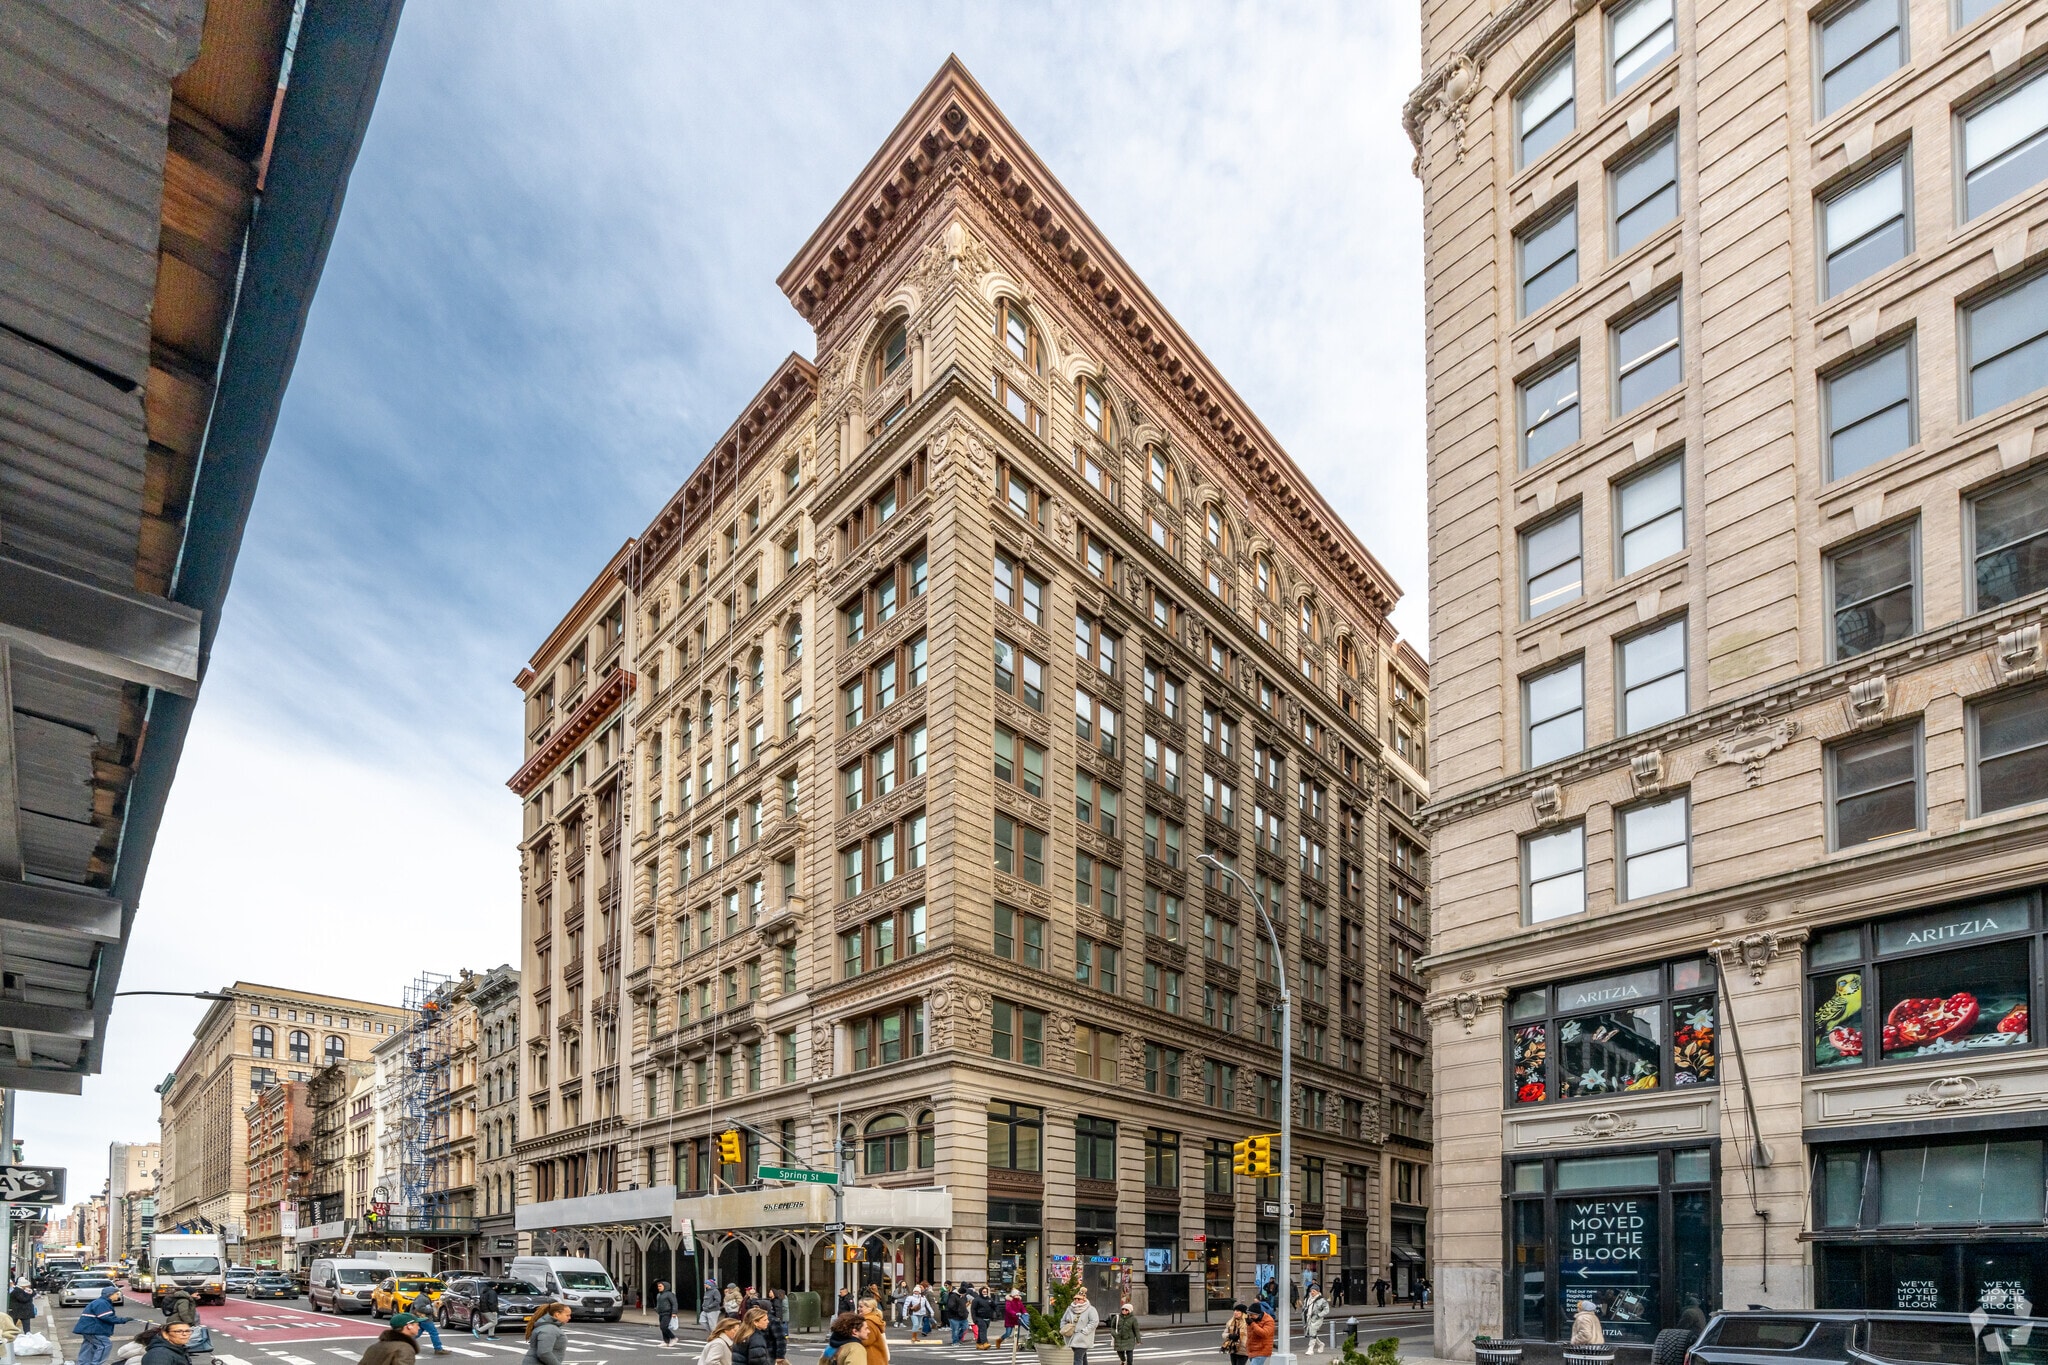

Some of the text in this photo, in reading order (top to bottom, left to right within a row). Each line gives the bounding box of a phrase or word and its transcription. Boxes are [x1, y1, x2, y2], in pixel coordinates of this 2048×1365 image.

[1905, 918, 1999, 945] ARITZIA
[1575, 985, 1639, 1005] ARITZIA
[779, 1170, 819, 1181] Spring St
[763, 1201, 805, 1212] SKECHERS
[1575, 1201, 1638, 1215] WE'VE
[1570, 1216, 1644, 1231] MOVED
[1571, 1231, 1643, 1245] UP THE
[1573, 1247, 1642, 1260] BLOCK
[1897, 1294, 1938, 1302] UP THE
[1982, 1302, 2024, 1310] BLOCK
